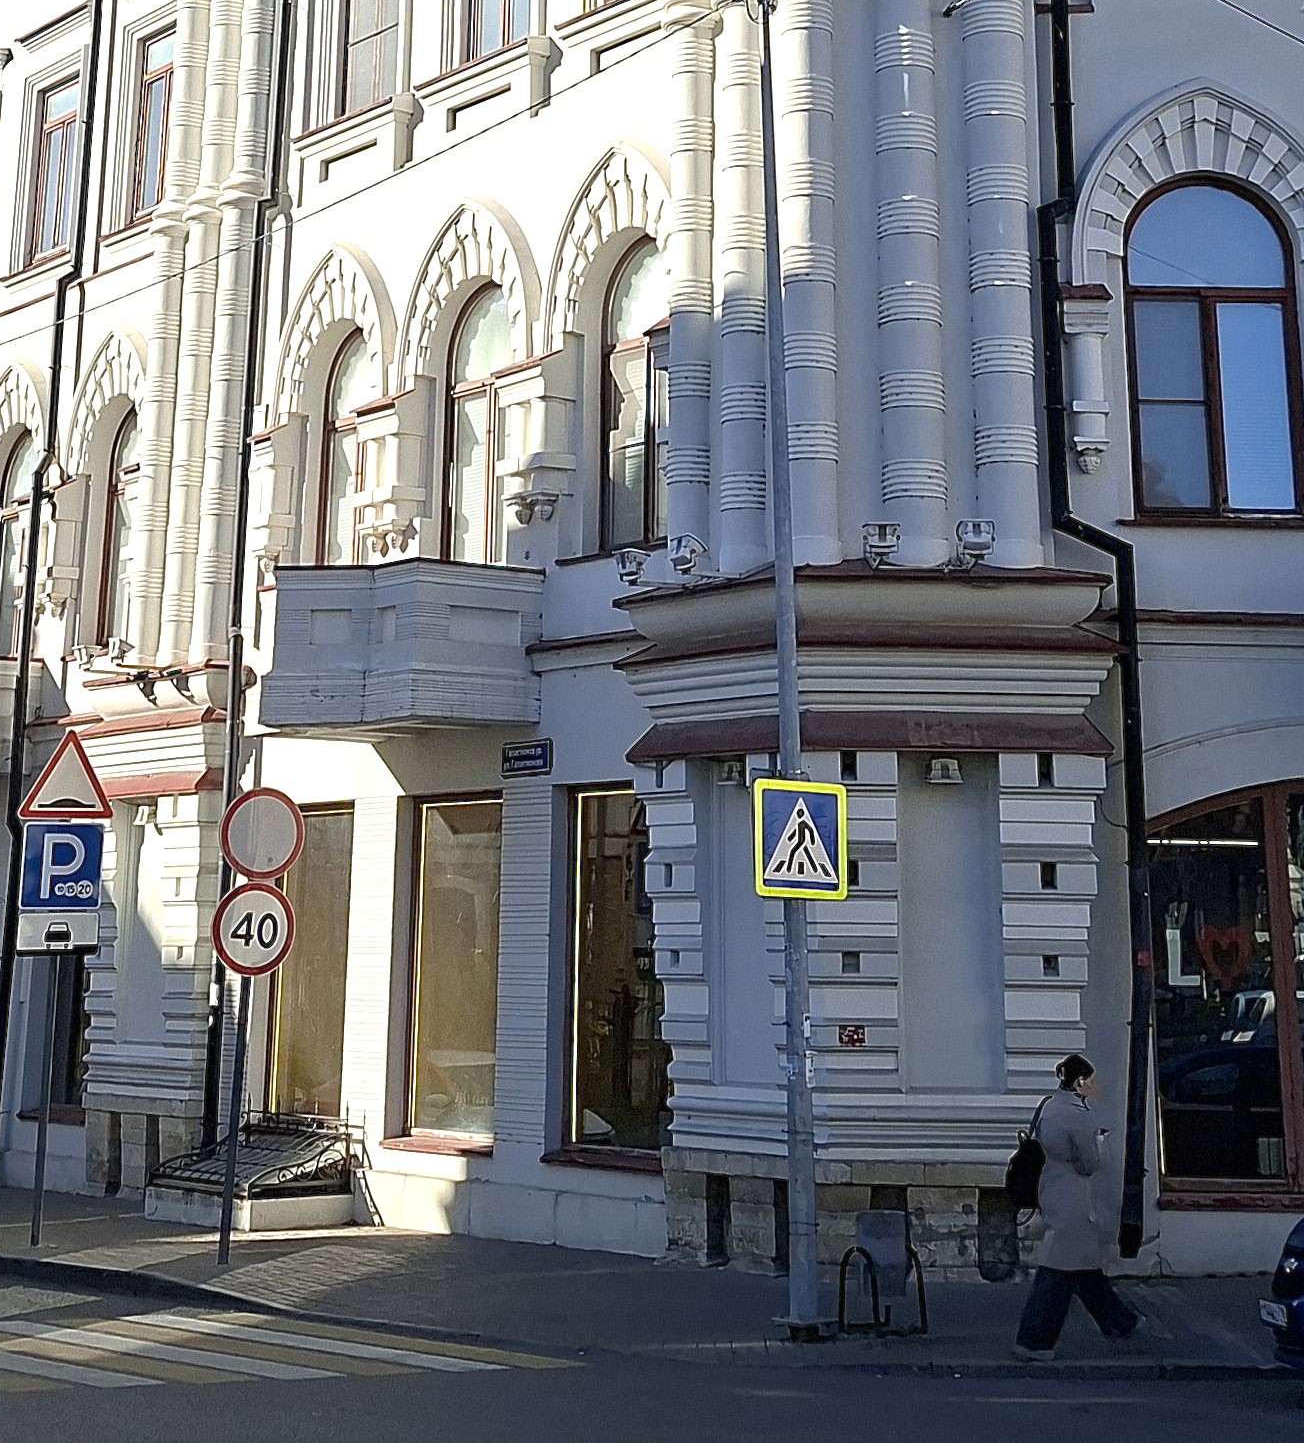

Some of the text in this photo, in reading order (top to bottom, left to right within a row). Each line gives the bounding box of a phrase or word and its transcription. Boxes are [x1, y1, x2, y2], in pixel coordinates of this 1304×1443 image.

[40, 833, 85, 899] P
[67, 884, 76, 893] 15
[77, 884, 91, 895] 20
[230, 911, 279, 949] 40
